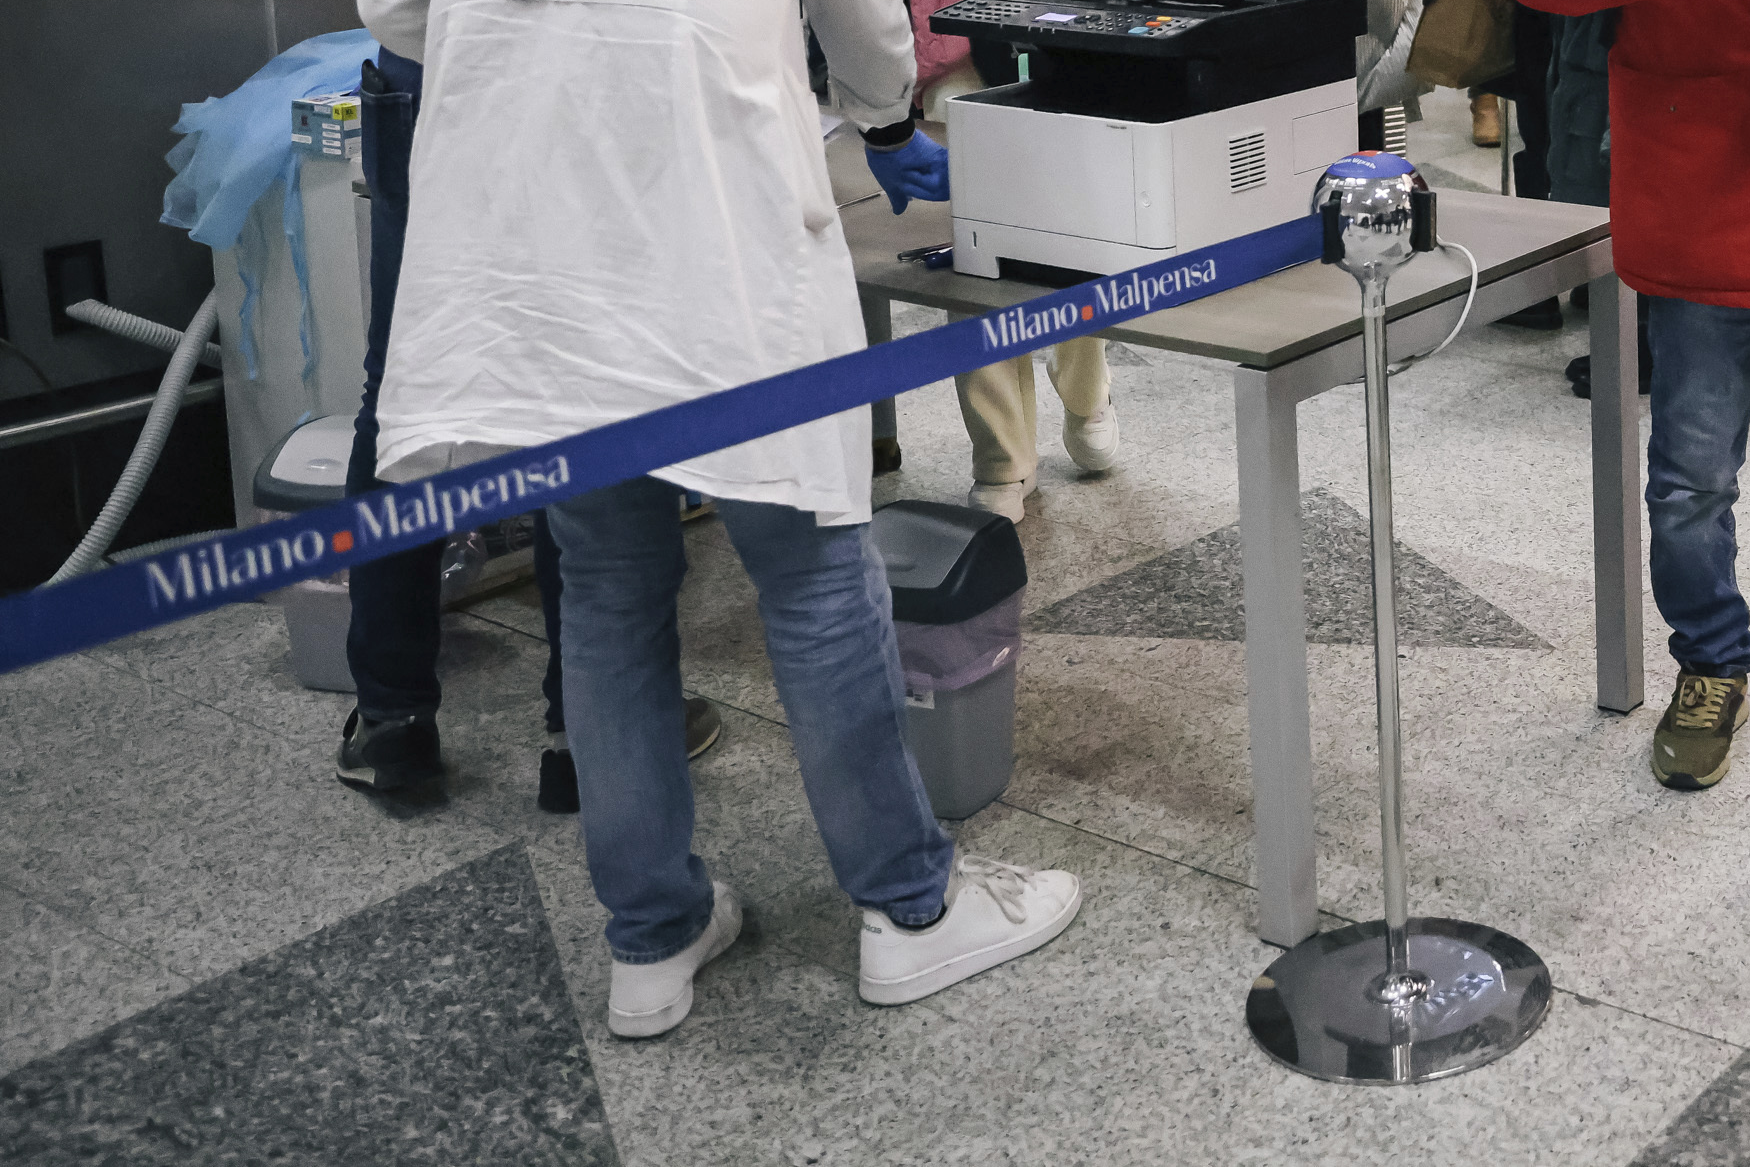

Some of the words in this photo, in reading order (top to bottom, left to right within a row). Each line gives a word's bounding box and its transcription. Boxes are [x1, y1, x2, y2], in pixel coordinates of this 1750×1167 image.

[981, 301, 1079, 352] Milano
[1092, 258, 1217, 315] Malpensa
[146, 529, 325, 612] Milano
[355, 454, 571, 546] Malpensa
